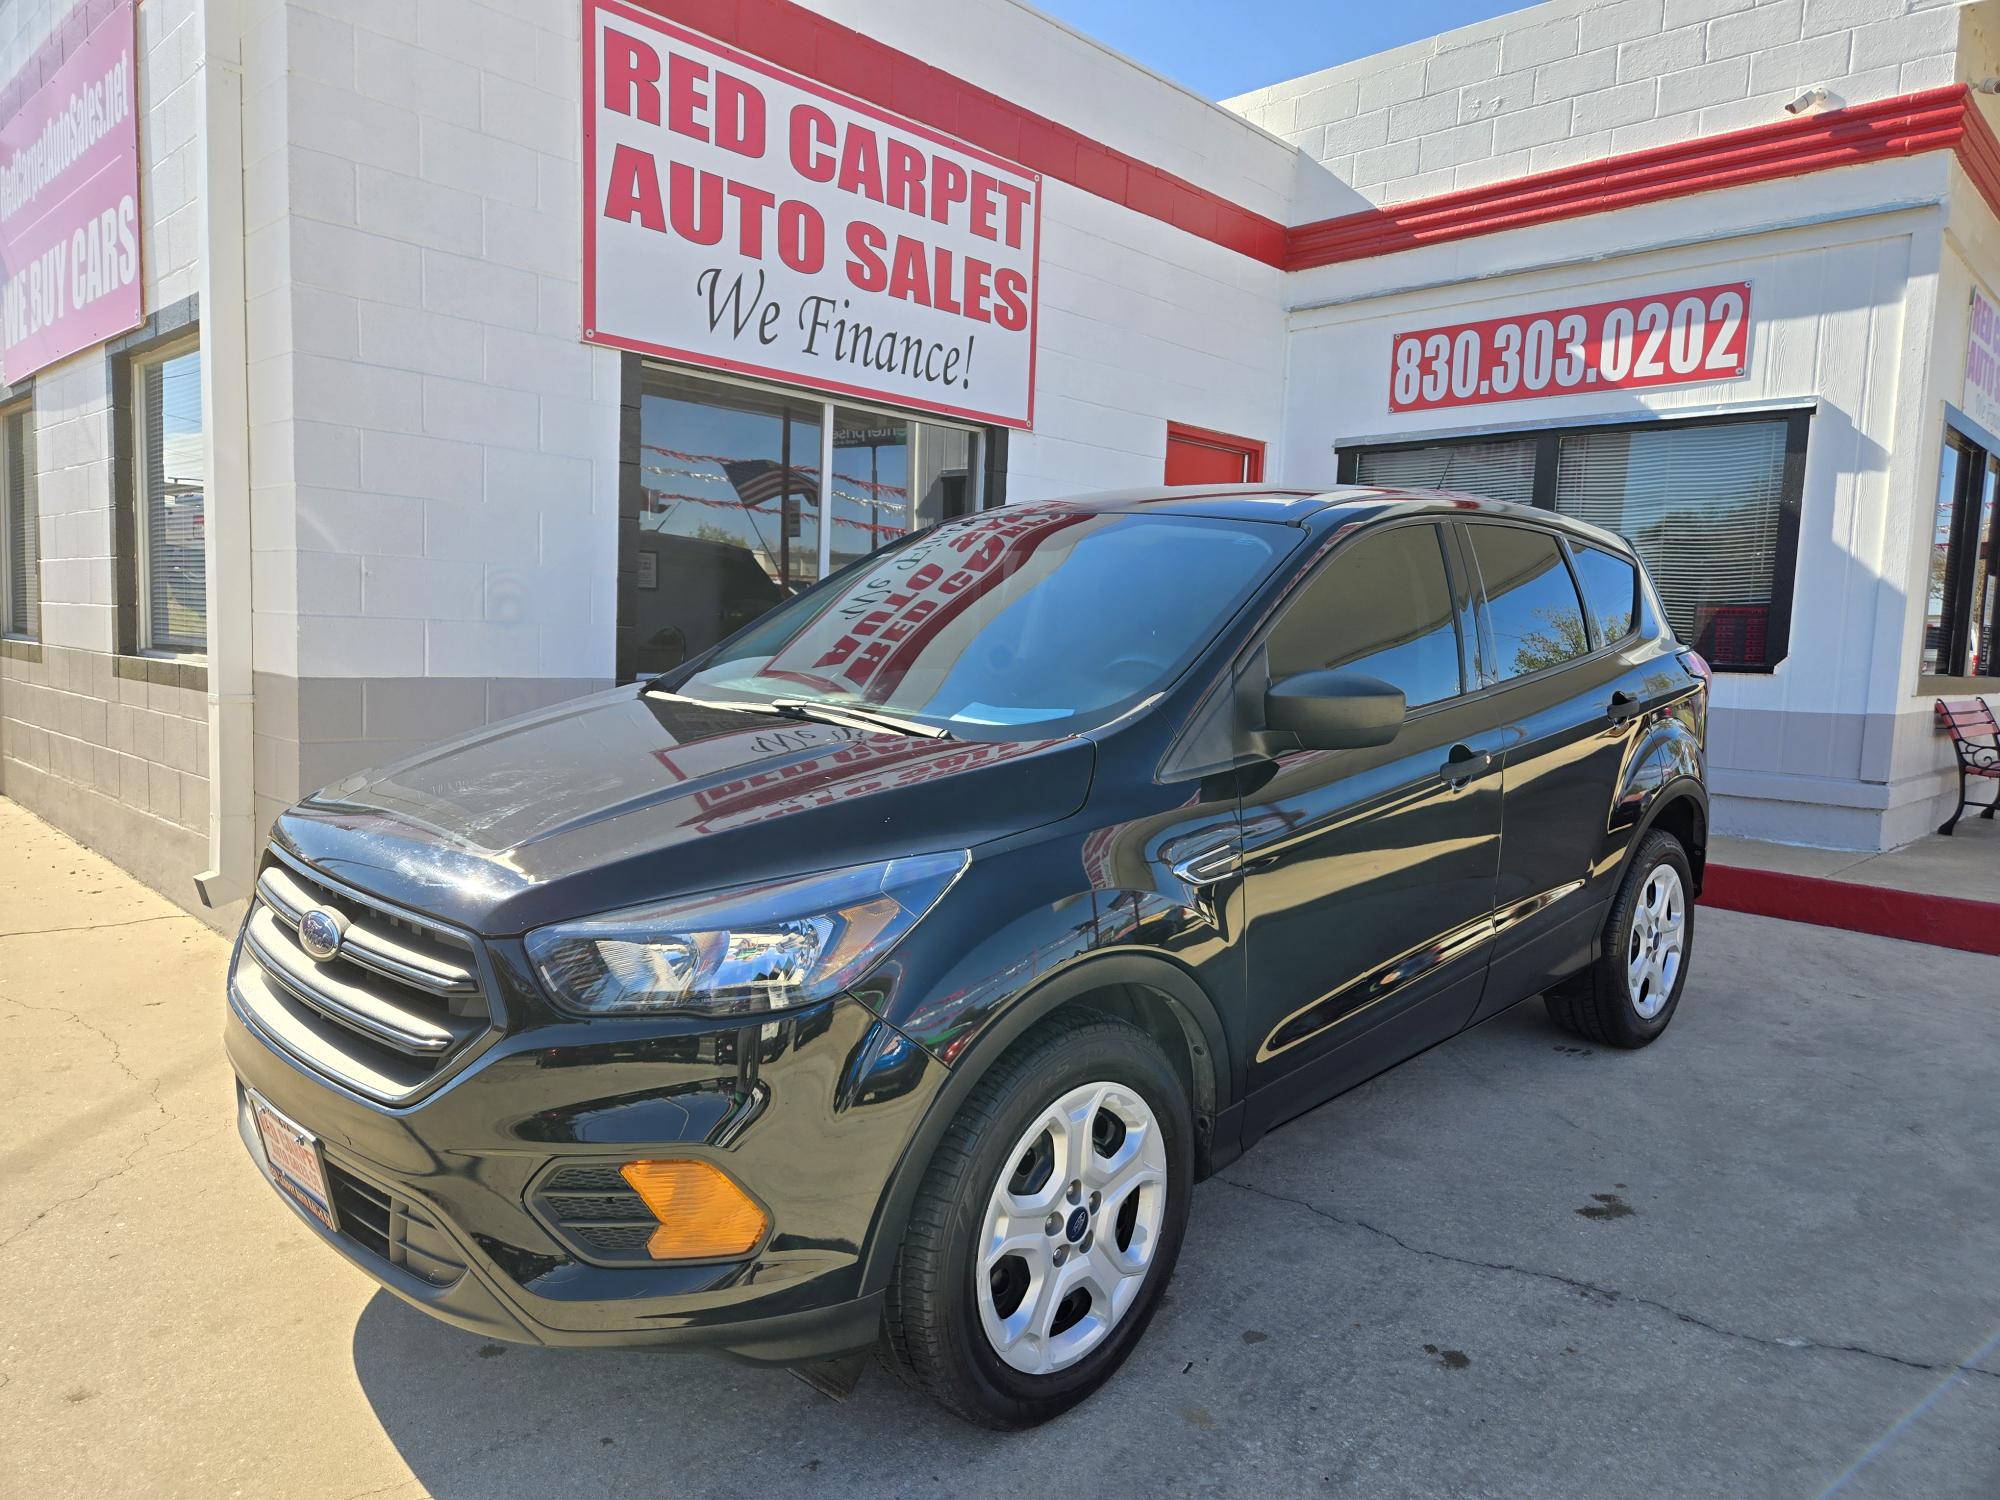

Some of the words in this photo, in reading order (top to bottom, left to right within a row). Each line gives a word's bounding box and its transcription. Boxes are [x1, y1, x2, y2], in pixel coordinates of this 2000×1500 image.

[604, 26, 766, 158] RED
[789, 104, 1031, 250] CARPET
[3, 269, 28, 352] WE
[30, 240, 68, 335] BUY
[72, 195, 135, 310] CARS
[604, 143, 825, 274] AUTO
[845, 220, 1028, 332] SALES
[697, 267, 780, 345] We
[799, 295, 975, 390] Finance!
[1394, 291, 1744, 405] 830.303.0202
